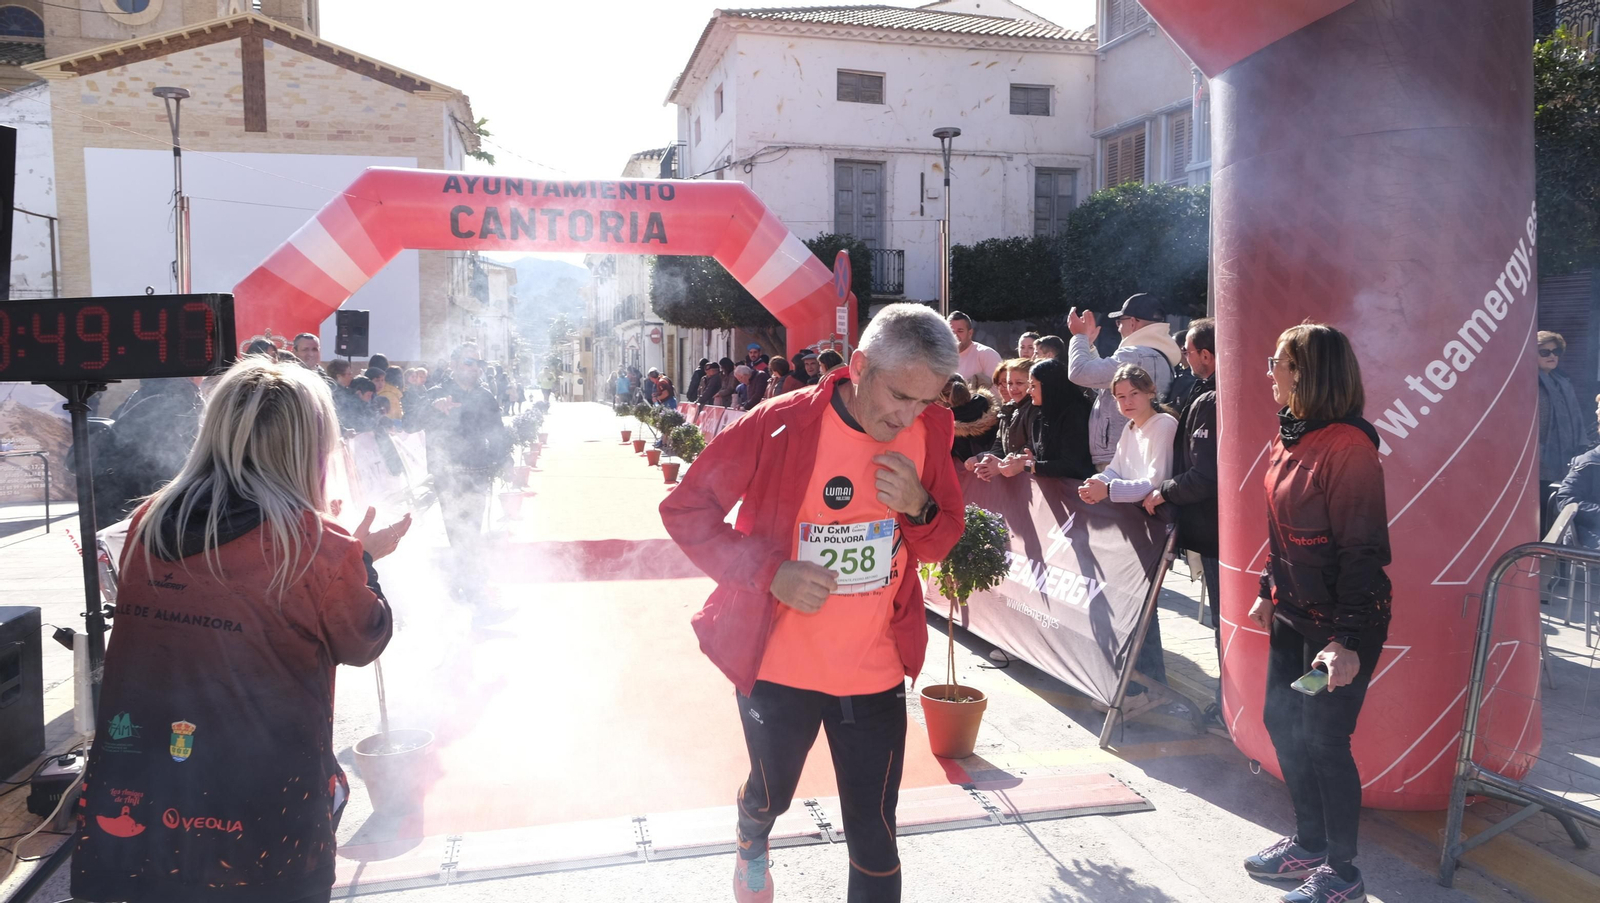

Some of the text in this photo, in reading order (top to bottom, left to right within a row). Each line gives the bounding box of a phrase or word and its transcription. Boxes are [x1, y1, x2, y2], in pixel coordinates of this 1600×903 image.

[442, 175, 676, 201] AYUNTAMIENTO
[449, 204, 668, 244] CANTORIA
[825, 487, 852, 496] LUMAI
[813, 526, 850, 534] IV CxM
[823, 534, 865, 543] PÓLVORA
[1288, 533, 1329, 546] Cntoria
[820, 545, 876, 575] 258
[134, 605, 149, 618] DE
[154, 609, 243, 633] ALMANZORA
[181, 817, 243, 831] VEOLIA
